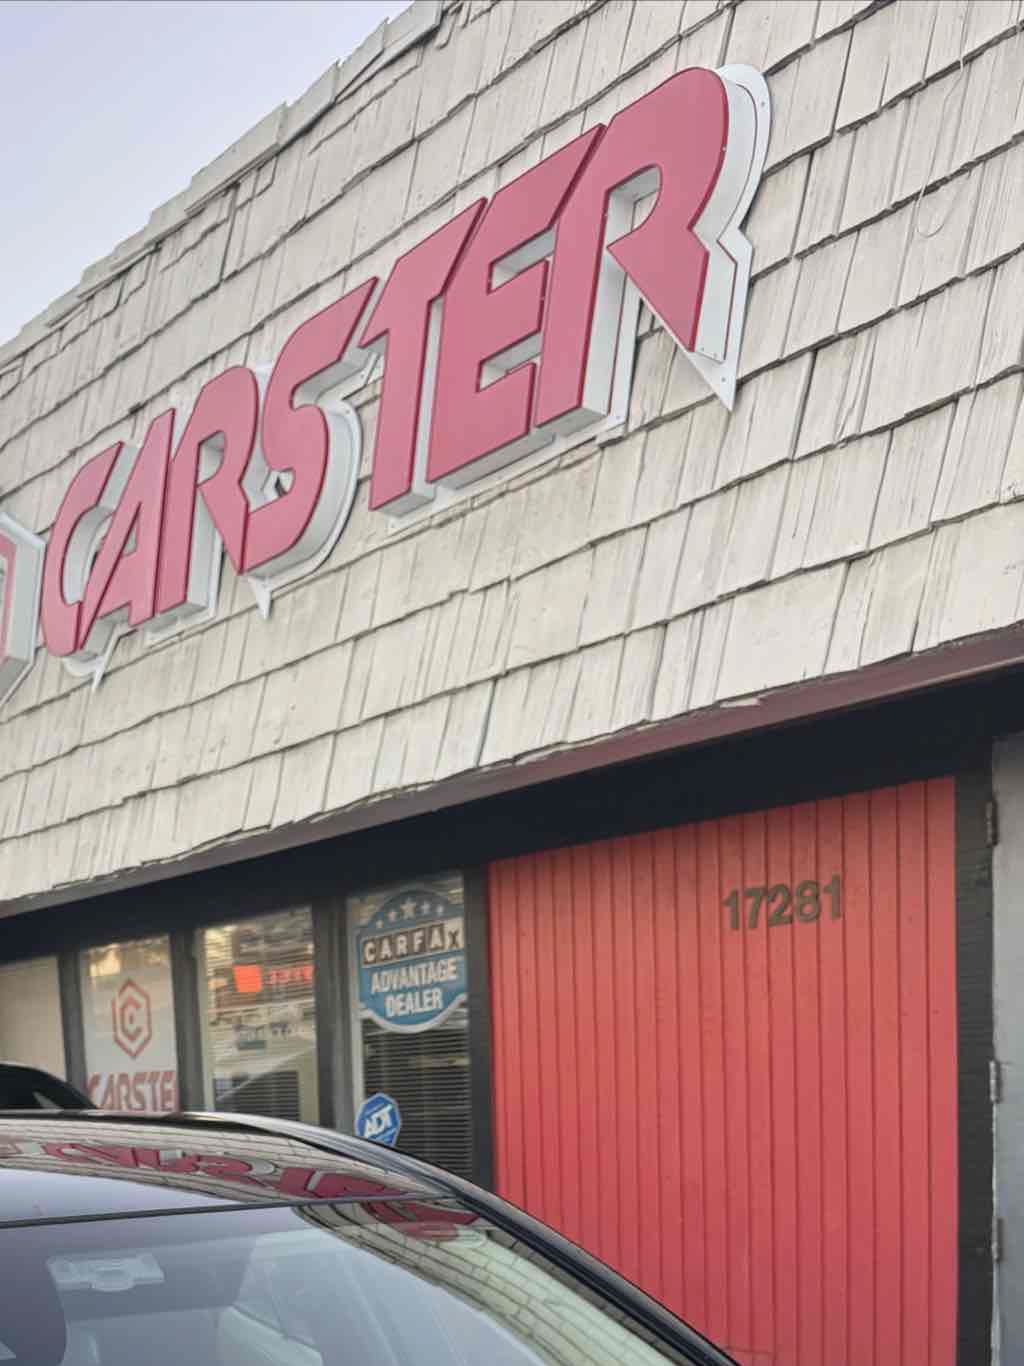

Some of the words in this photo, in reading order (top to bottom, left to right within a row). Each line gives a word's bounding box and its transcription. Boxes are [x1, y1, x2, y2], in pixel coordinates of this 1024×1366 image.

[40, 65, 748, 662] CARSTER
[721, 873, 842, 931] 17281
[363, 919, 464, 964] CARFAX
[370, 956, 458, 996] ADVANTAGE
[384, 988, 443, 1019] DEALER
[87, 1070, 177, 1113] CARSTE
[364, 1103, 394, 1138] ADT
